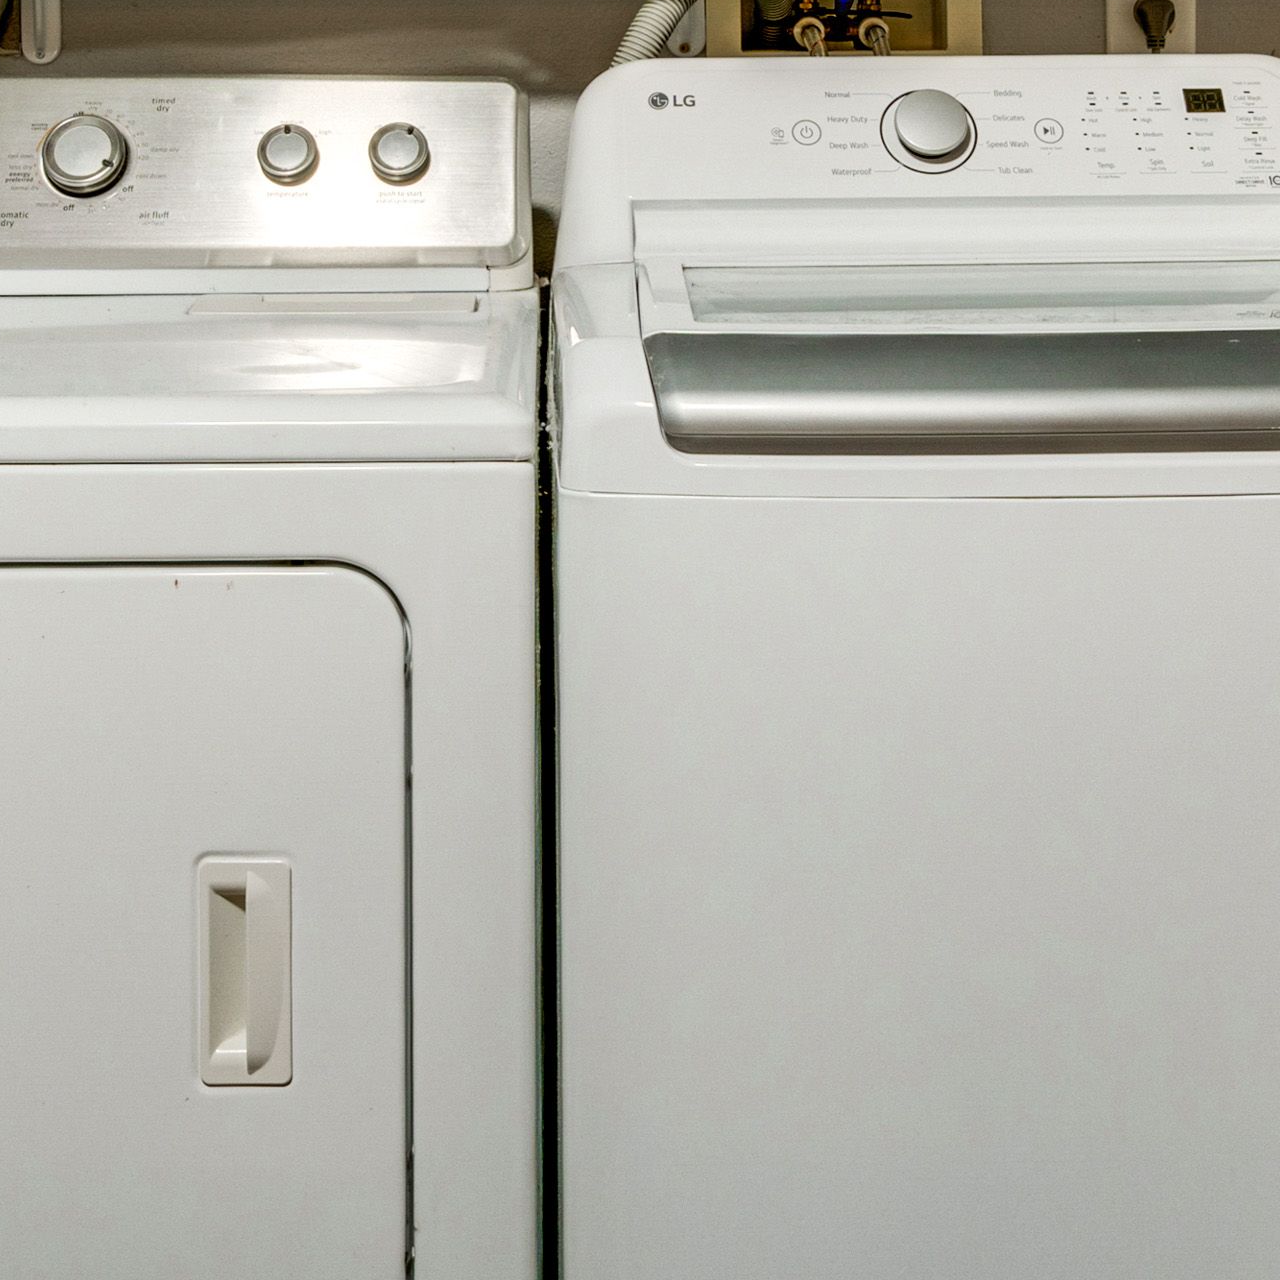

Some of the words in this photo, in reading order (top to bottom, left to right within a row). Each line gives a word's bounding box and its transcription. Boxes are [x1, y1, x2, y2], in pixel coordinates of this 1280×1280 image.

[993, 89, 1023, 98] Bedding
[673, 95, 696, 107] LG
[827, 116, 849, 124] Heavy
[851, 116, 868, 124] Duty
[829, 142, 847, 150] Deep
[849, 141, 869, 149] Wash
[986, 140, 1008, 149] Speed
[1009, 140, 1029, 148] Wash
[1201, 159, 1214, 168] Soil
[831, 168, 872, 176] Waterproof
[998, 166, 1011, 174] Tub
[1012, 166, 1033, 174] Clean
[122, 185, 134, 193] off
[63, 204, 74, 212] off
[152, 211, 169, 219] fluff
